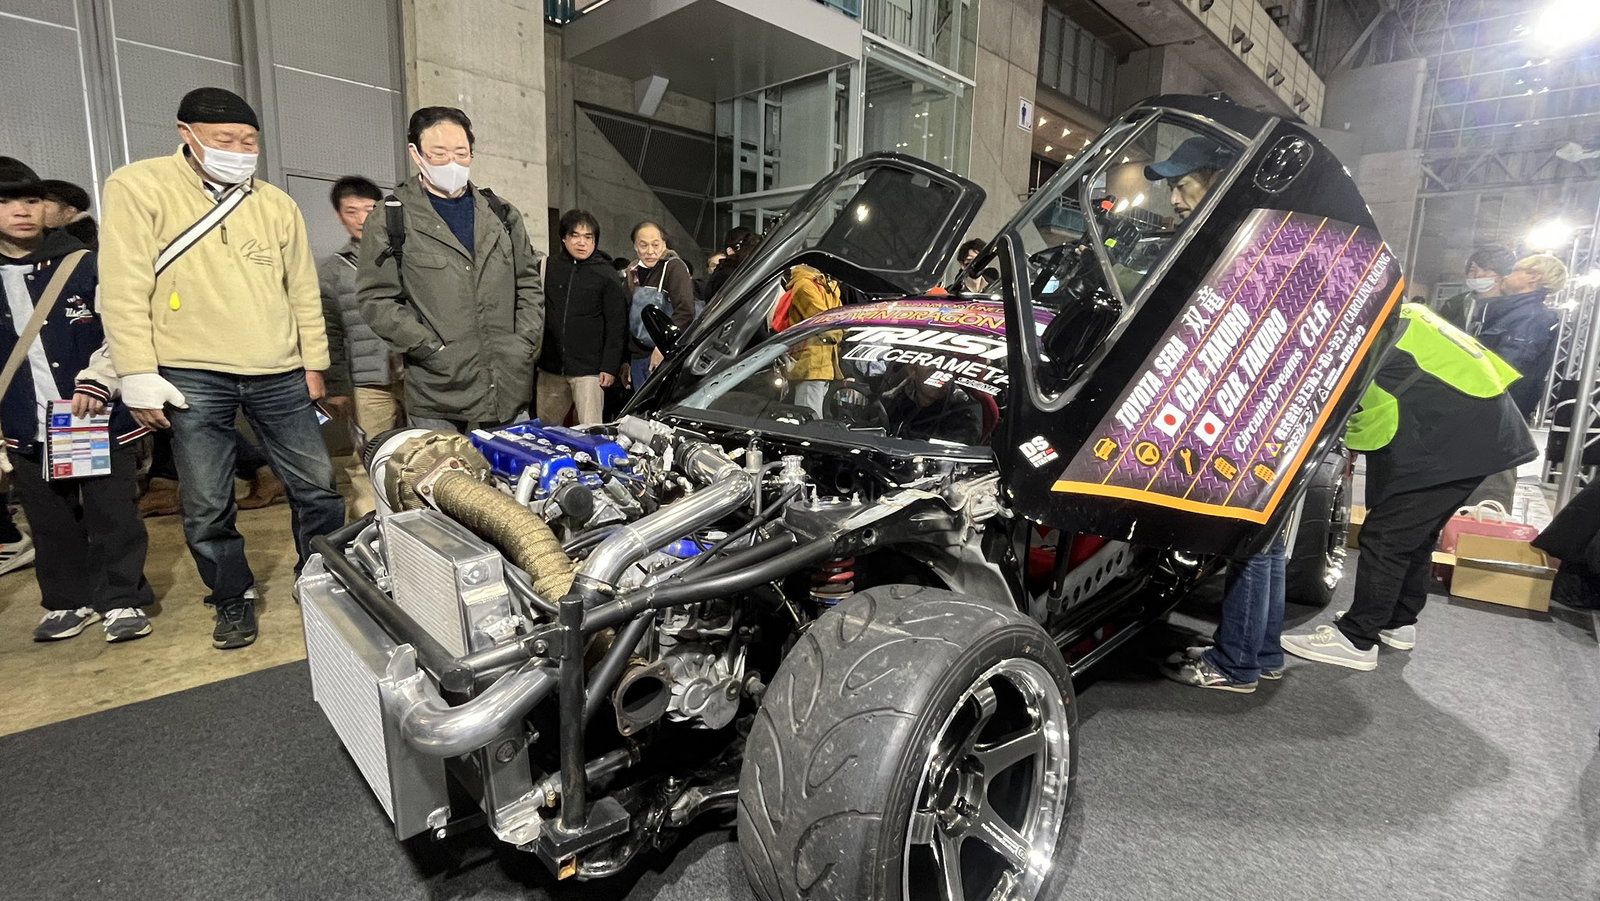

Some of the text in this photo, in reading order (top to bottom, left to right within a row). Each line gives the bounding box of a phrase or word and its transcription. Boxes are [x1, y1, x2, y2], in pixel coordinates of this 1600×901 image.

[1343, 281, 1375, 323] CAROLINE
[1369, 252, 1391, 286] RACING
[894, 309, 1005, 331] DRAGON
[1198, 302, 1252, 371] TAKURO
[1239, 307, 1289, 380] TAKURO
[1300, 300, 1332, 349] CLR
[931, 371, 953, 382] DS
[1115, 284, 1226, 432] TOYOTA SERA 双竜
[1019, 436, 1049, 458] DS
